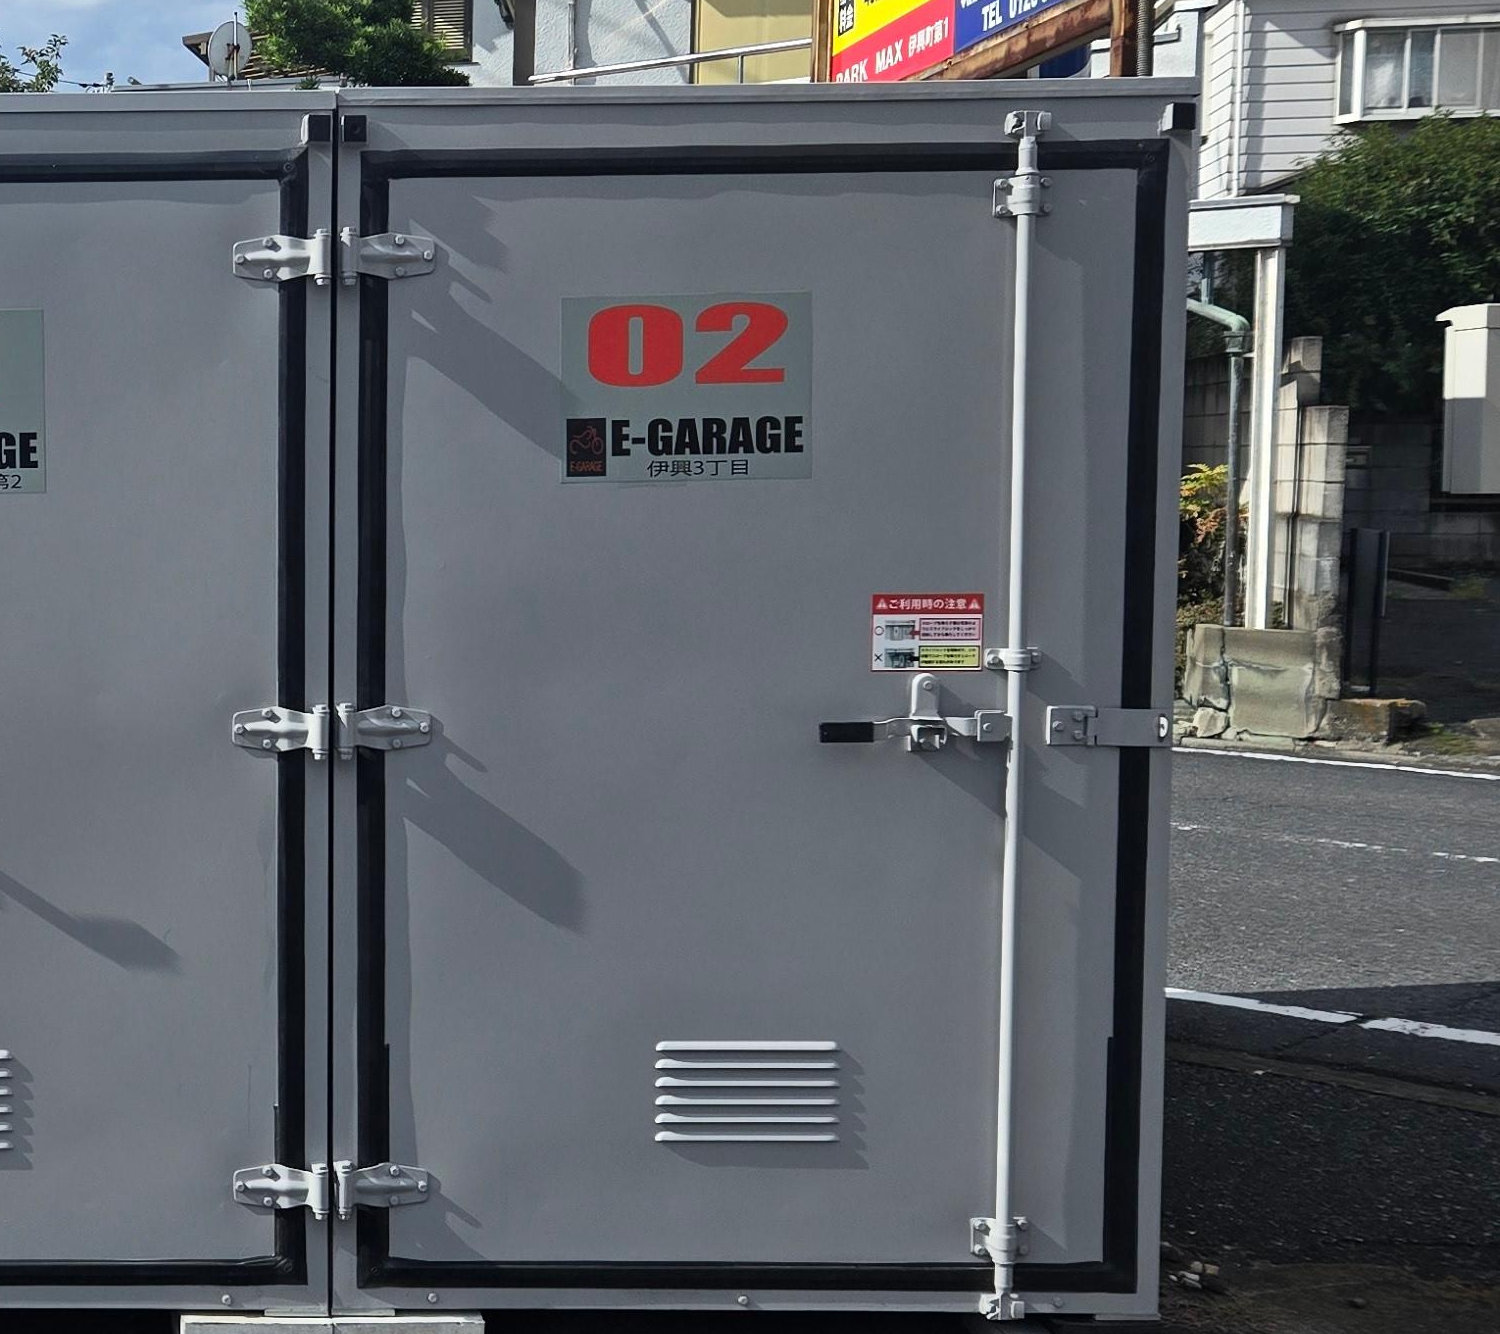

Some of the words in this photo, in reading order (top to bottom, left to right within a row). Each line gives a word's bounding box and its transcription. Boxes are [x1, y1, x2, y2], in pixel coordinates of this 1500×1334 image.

[981, 0, 1003, 32] TEL
[875, 39, 904, 75] MAX
[587, 300, 789, 388] 02
[611, 415, 805, 458] E-GARAGE
[646, 458, 750, 478] 伊興3丁目
[888, 598, 968, 610] ご利用時の注意
